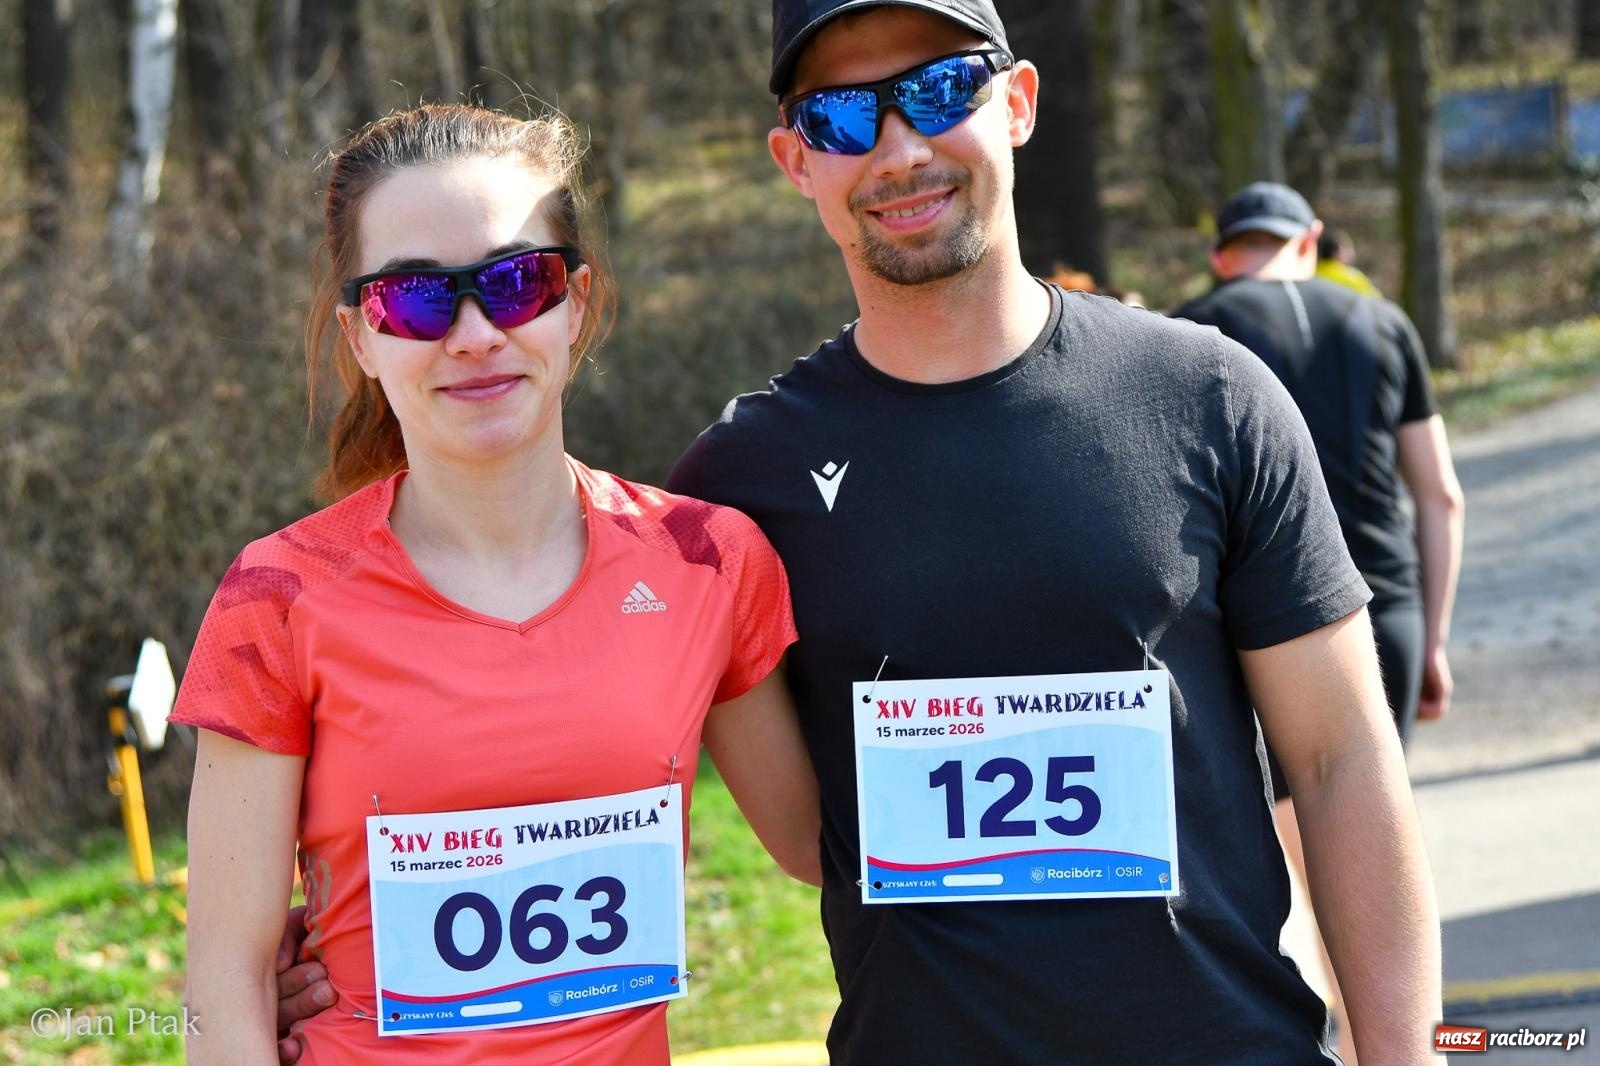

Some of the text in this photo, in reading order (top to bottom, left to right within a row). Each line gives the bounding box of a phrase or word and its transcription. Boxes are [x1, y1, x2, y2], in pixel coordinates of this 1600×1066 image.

[621, 600, 667, 614] adidas
[876, 689, 1146, 719] XIV BIEG TWARDZIELA
[876, 723, 985, 738] 15 marzec 2026
[928, 755, 1102, 839] 125
[390, 807, 660, 854] XIV BIEG TWARDZIELA
[390, 854, 503, 872] 15 marzec 2026
[1115, 866, 1143, 877] OSiR
[1047, 867, 1103, 879] Racibórz
[433, 876, 629, 972] 063
[629, 975, 655, 989] OSiR
[566, 983, 618, 1000] Racibórz
